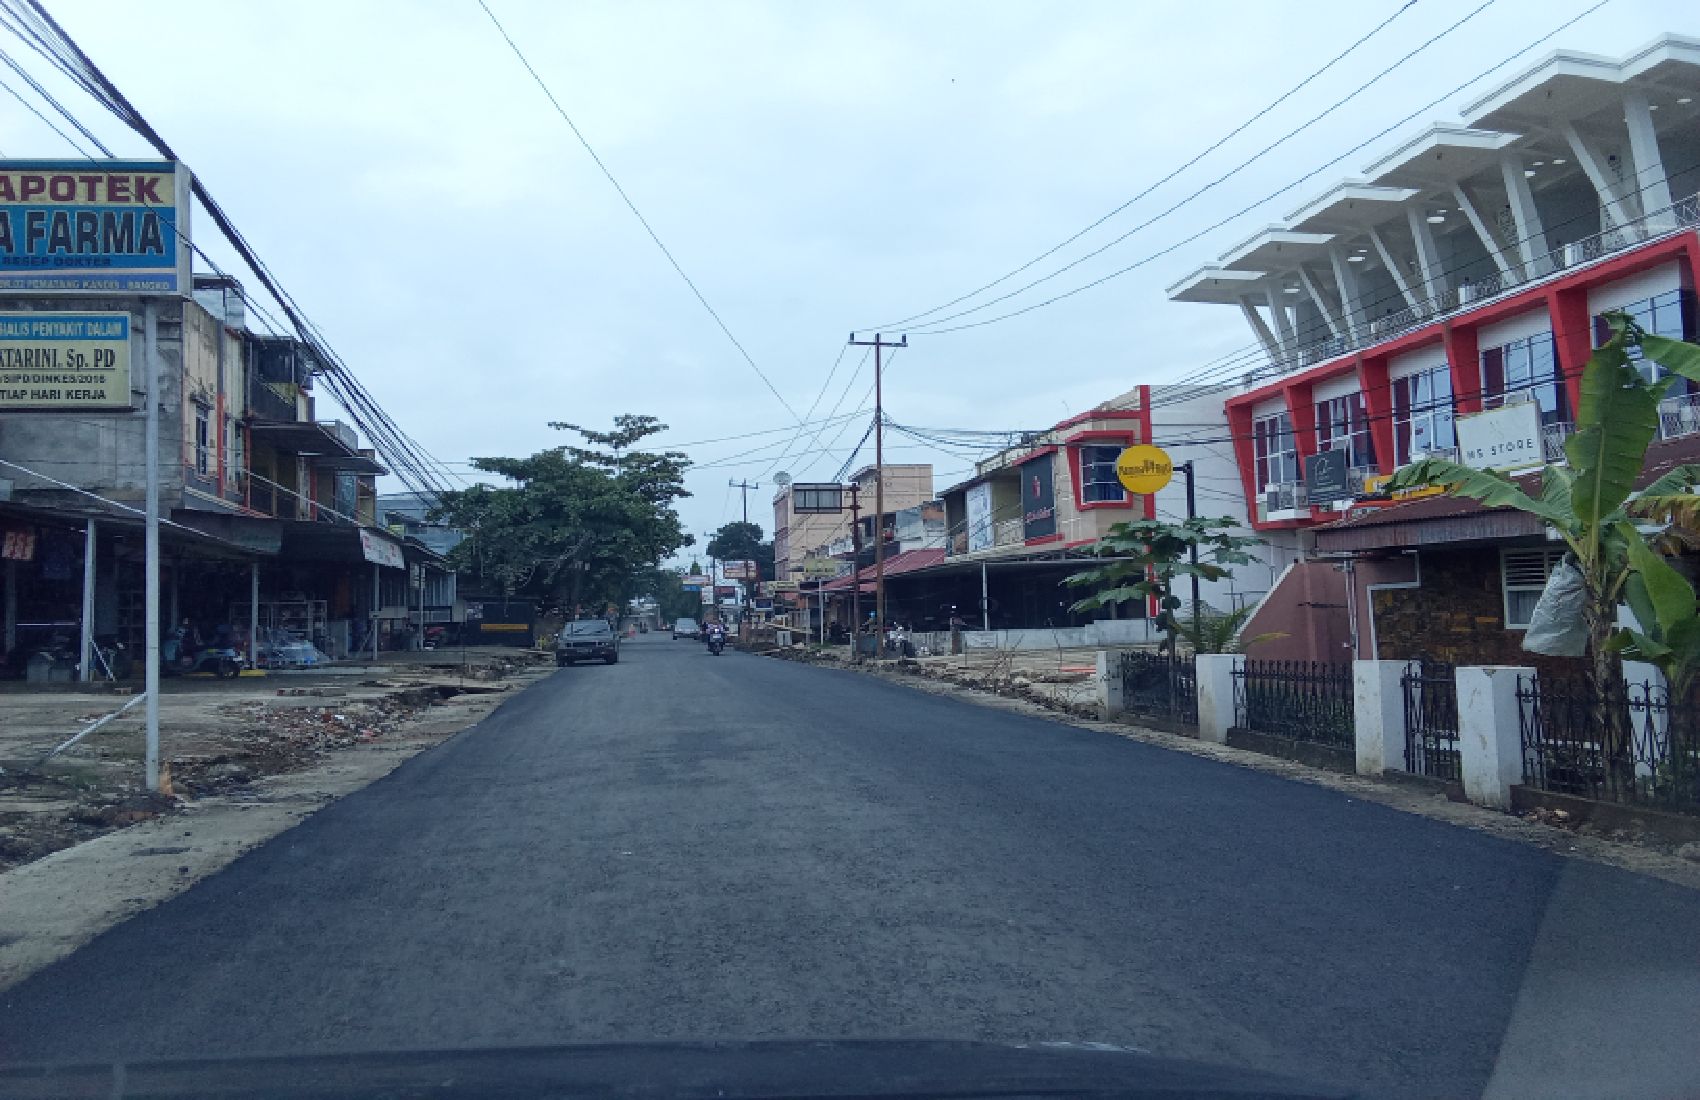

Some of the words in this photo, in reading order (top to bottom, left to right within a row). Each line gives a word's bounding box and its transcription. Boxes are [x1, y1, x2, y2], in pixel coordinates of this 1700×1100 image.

[0, 175, 163, 204] APOTEK
[25, 209, 165, 257] FARMA
[0, 321, 30, 337] IALIS
[32, 321, 84, 337] PENYAKIT
[87, 321, 122, 337] DALAM
[30, 389, 61, 400] HARI
[65, 389, 107, 400] KERJA
